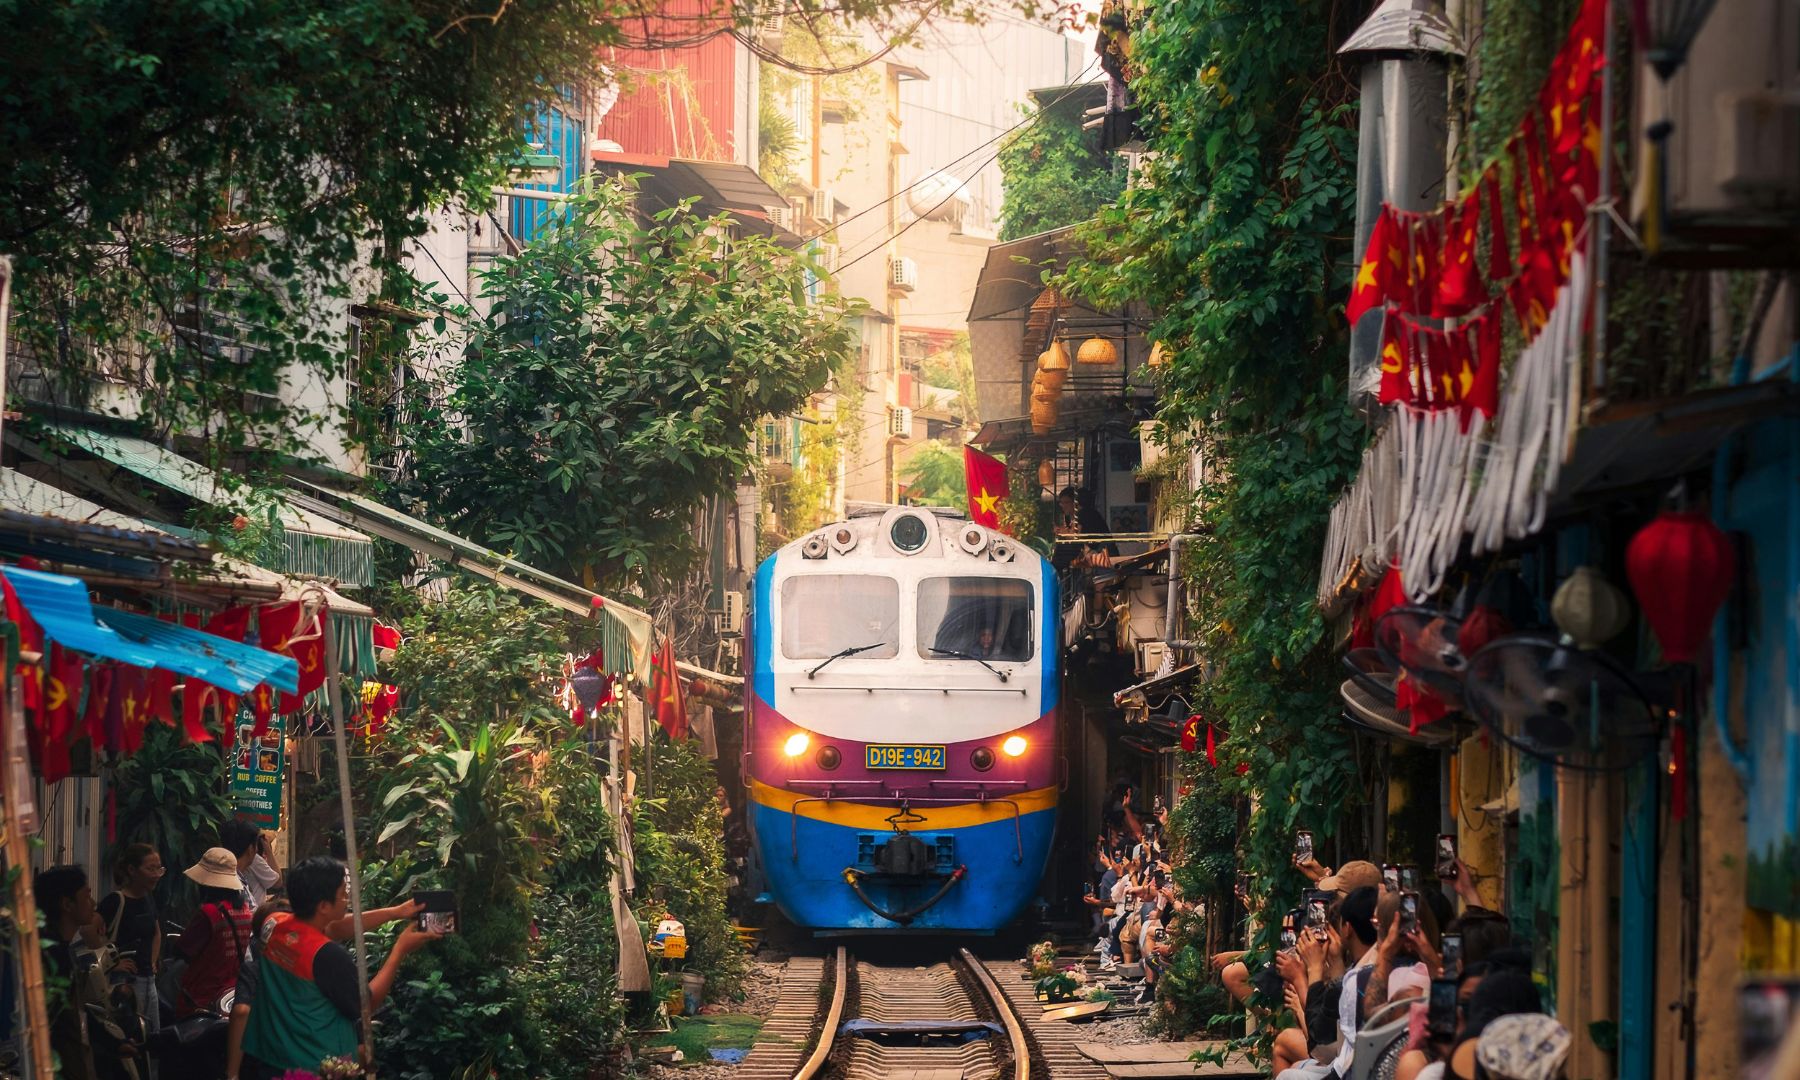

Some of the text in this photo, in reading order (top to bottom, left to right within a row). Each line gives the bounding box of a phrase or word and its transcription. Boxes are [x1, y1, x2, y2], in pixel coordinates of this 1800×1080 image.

[870, 748, 941, 766] D19E-942
[255, 774, 277, 784] COFFEE
[239, 800, 273, 810] MOOTHIES
